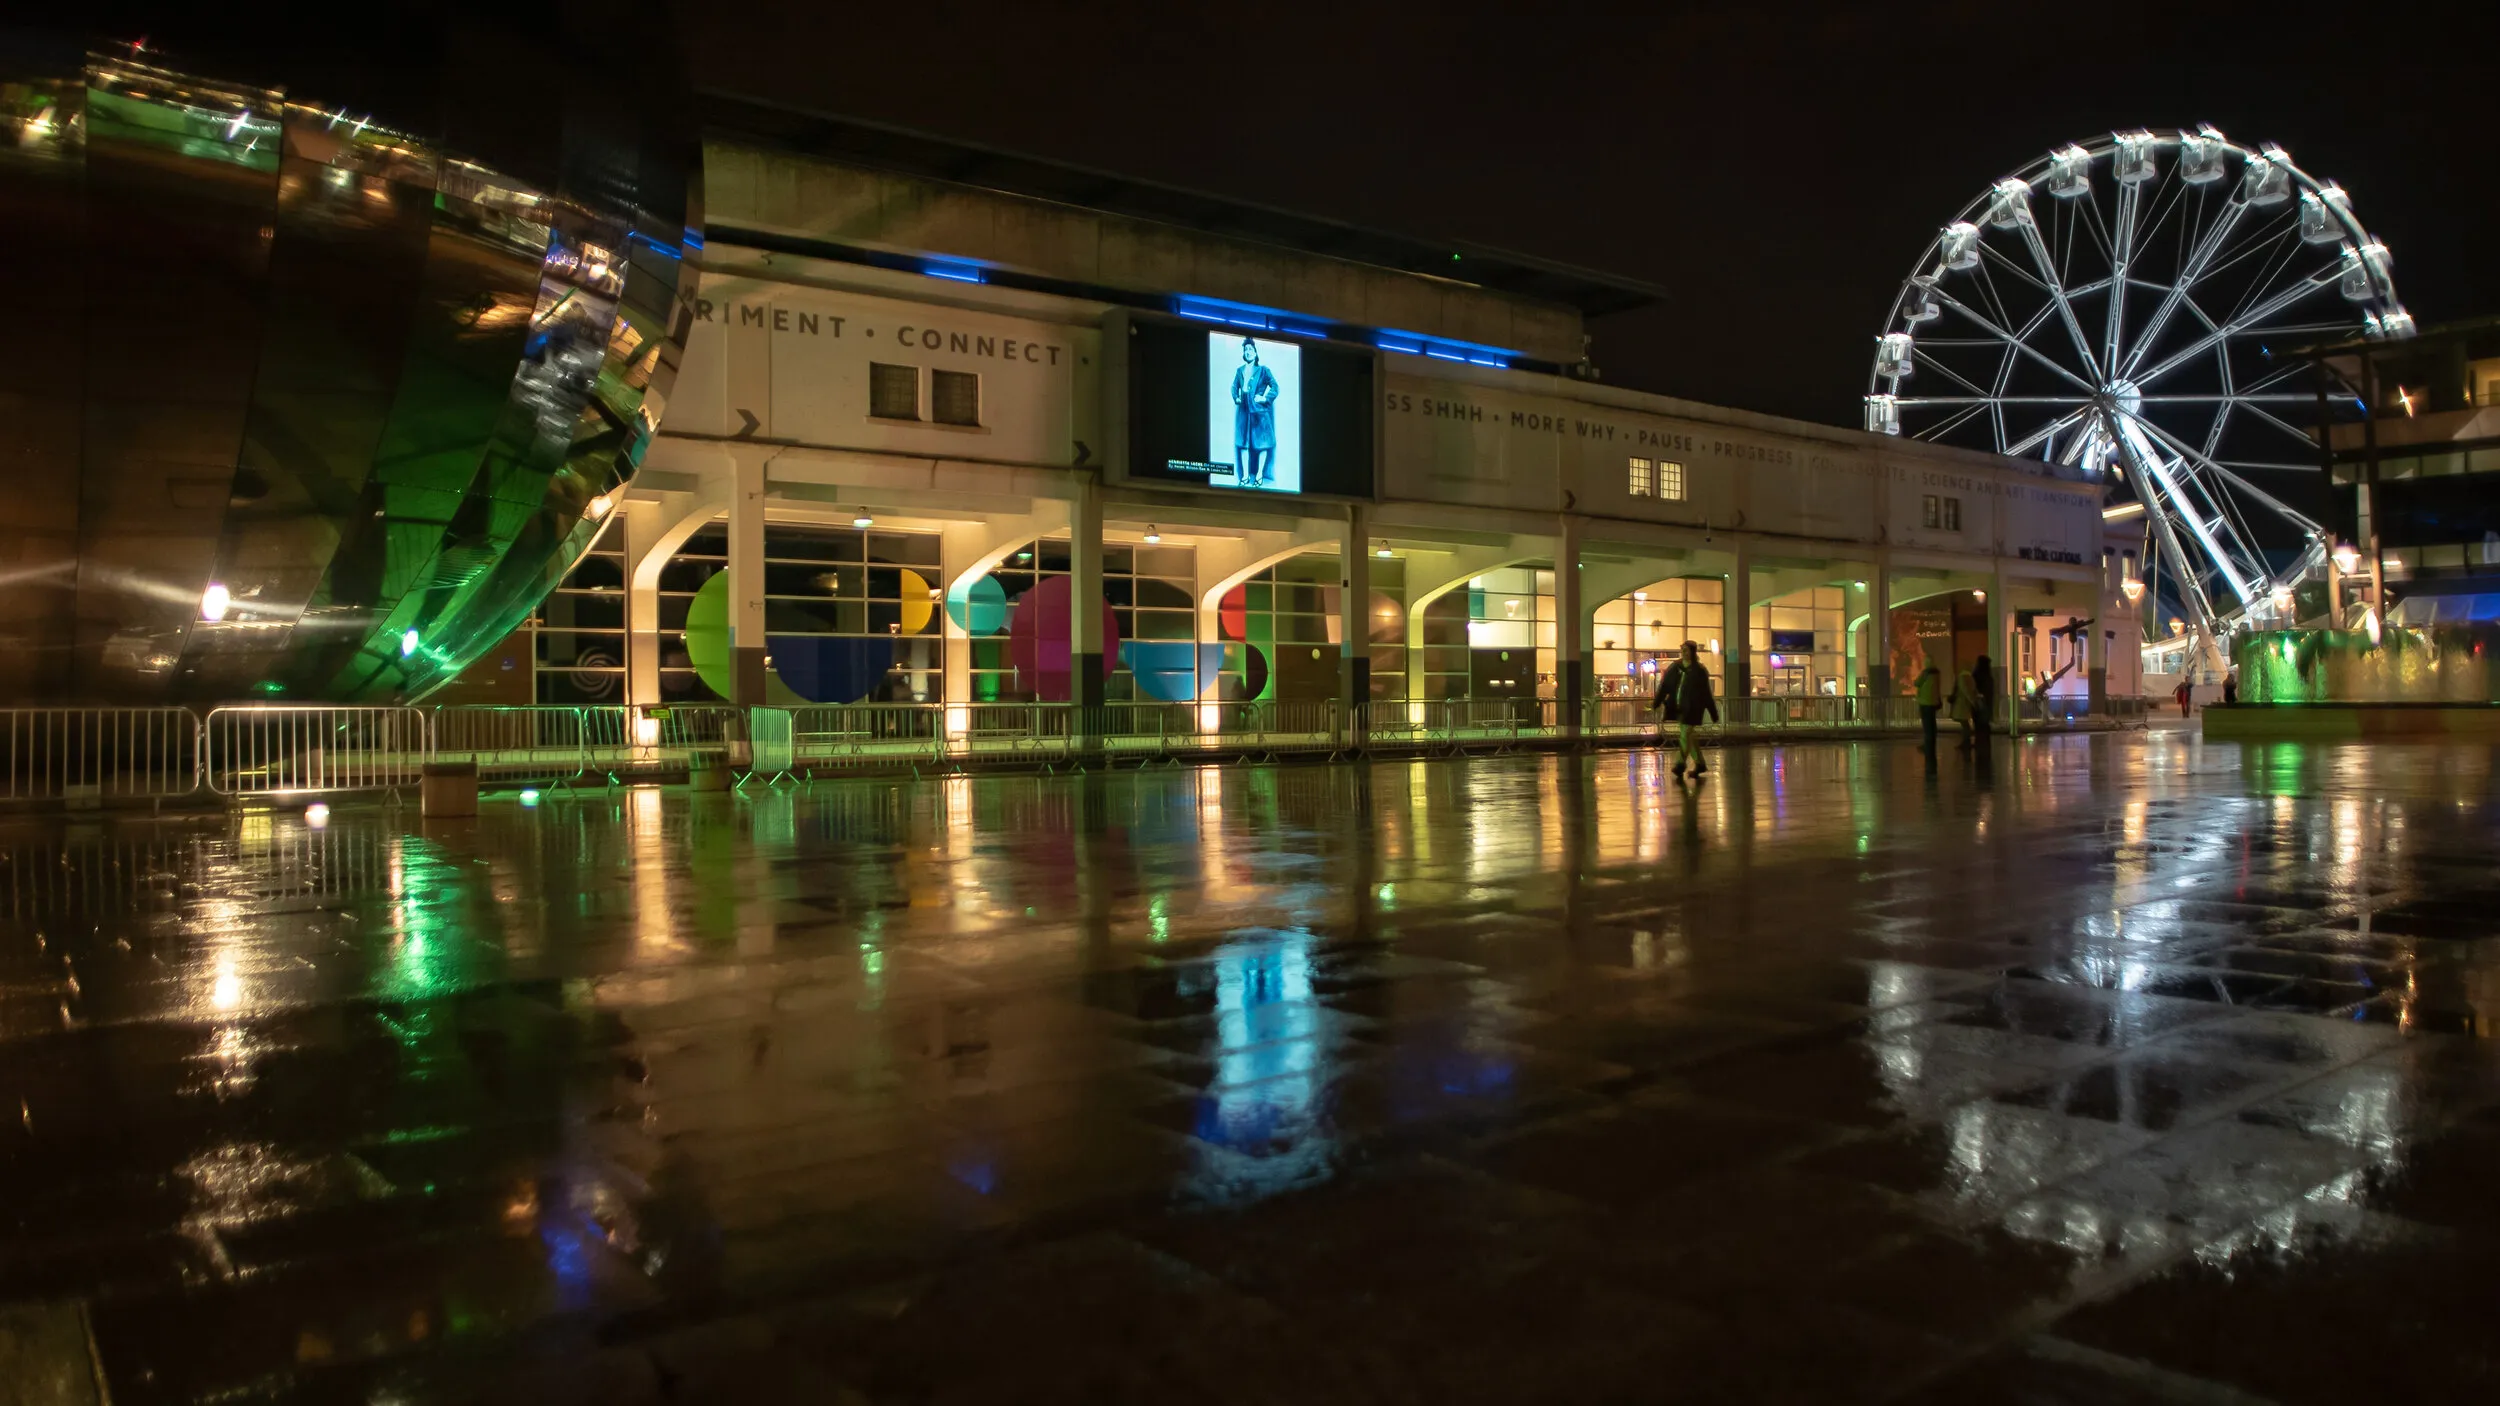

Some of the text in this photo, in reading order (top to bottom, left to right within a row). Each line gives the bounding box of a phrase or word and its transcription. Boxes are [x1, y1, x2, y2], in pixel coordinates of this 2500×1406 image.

[694, 299, 1061, 366] RIMENT CONNECT
[1387, 393, 1412, 412] SS
[1422, 398, 1482, 422] SHHH
[1511, 411, 1566, 434] MORE
[1575, 420, 1615, 440] WHY
[1639, 430, 1692, 452] PAUSE
[1714, 441, 1793, 465] PROGRESS
[1812, 456, 1907, 481] COLORATE
[1922, 472, 1972, 491] SCIENCE
[1977, 481, 2002, 495] AND
[2029, 488, 2092, 508] TRANSFORM
[2018, 545, 2082, 565] we the curious
